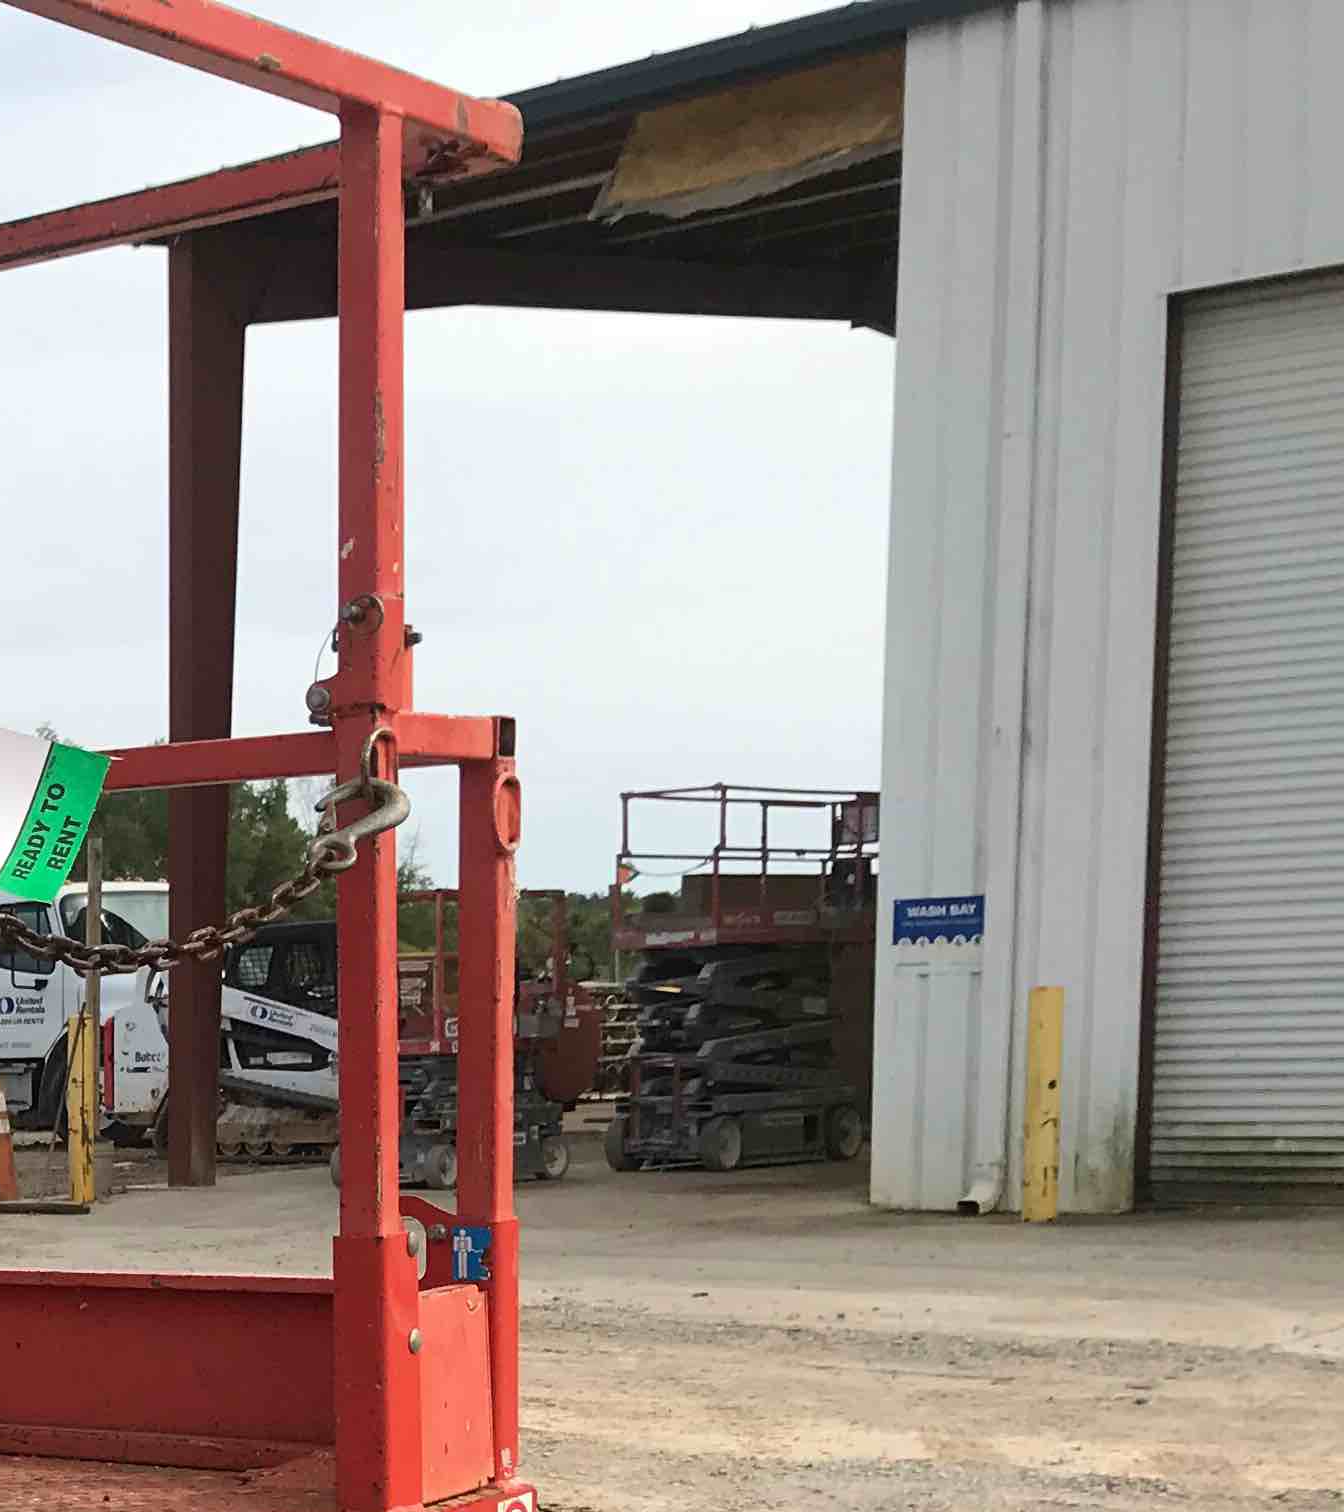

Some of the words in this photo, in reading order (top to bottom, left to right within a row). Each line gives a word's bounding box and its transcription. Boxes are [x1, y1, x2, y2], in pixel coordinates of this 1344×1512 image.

[12, 820, 52, 880] READY
[41, 782, 66, 819] TO
[47, 815, 83, 870] RENT
